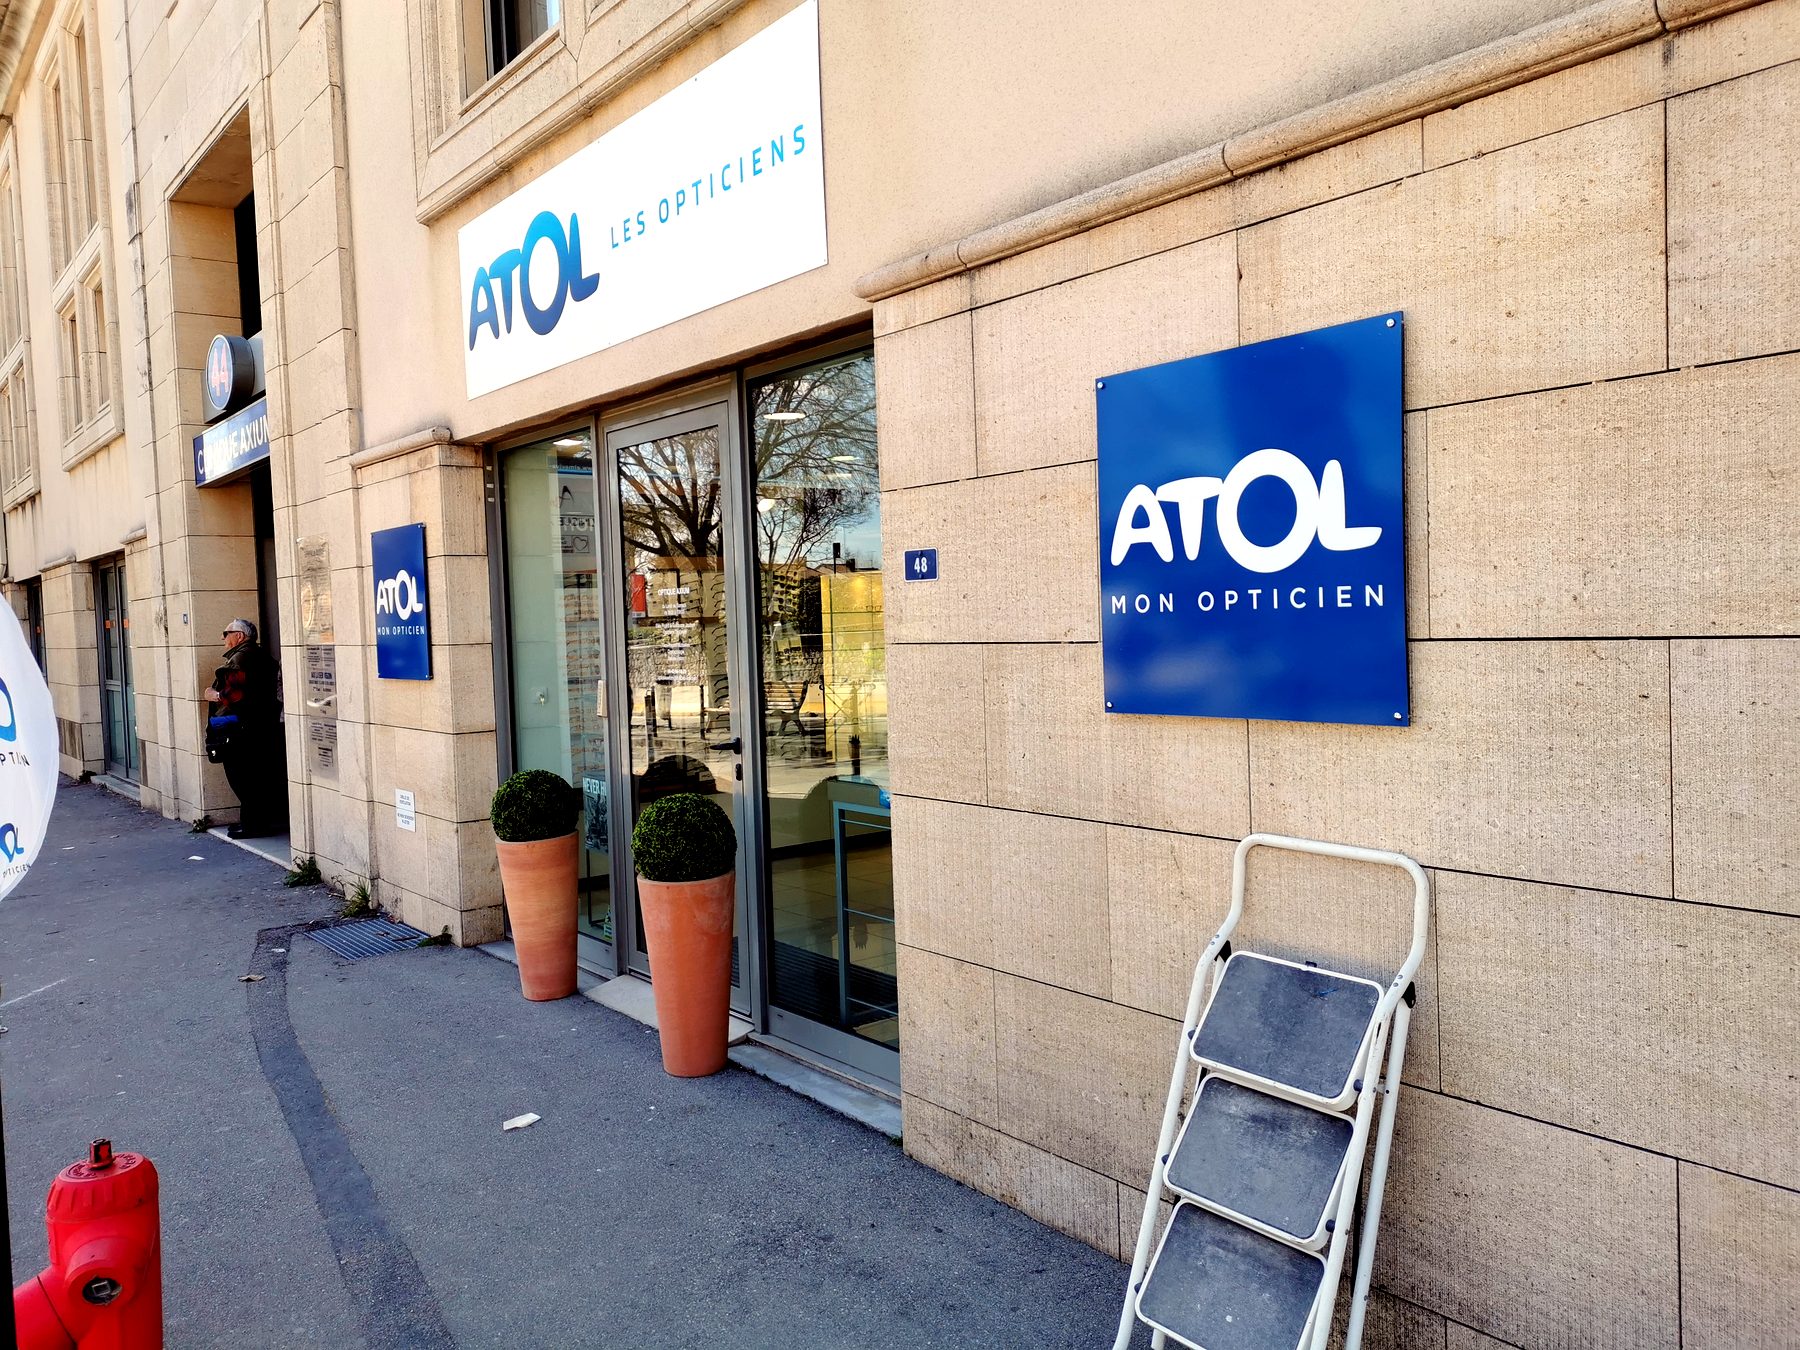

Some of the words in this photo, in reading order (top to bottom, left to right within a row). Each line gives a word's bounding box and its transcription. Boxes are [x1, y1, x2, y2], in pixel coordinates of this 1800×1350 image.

[610, 211, 645, 249] LES
[658, 124, 807, 224] OPTICIENS
[470, 210, 600, 351] ATOL
[211, 342, 230, 397] 44
[1110, 448, 1383, 574] ATOL
[914, 556, 928, 573] 48
[376, 569, 424, 620] ATOL
[1111, 592, 1174, 614] MON
[1197, 584, 1384, 612] OPTICIEN
[377, 626, 390, 635] MON
[393, 625, 425, 635] OPTICIEN
